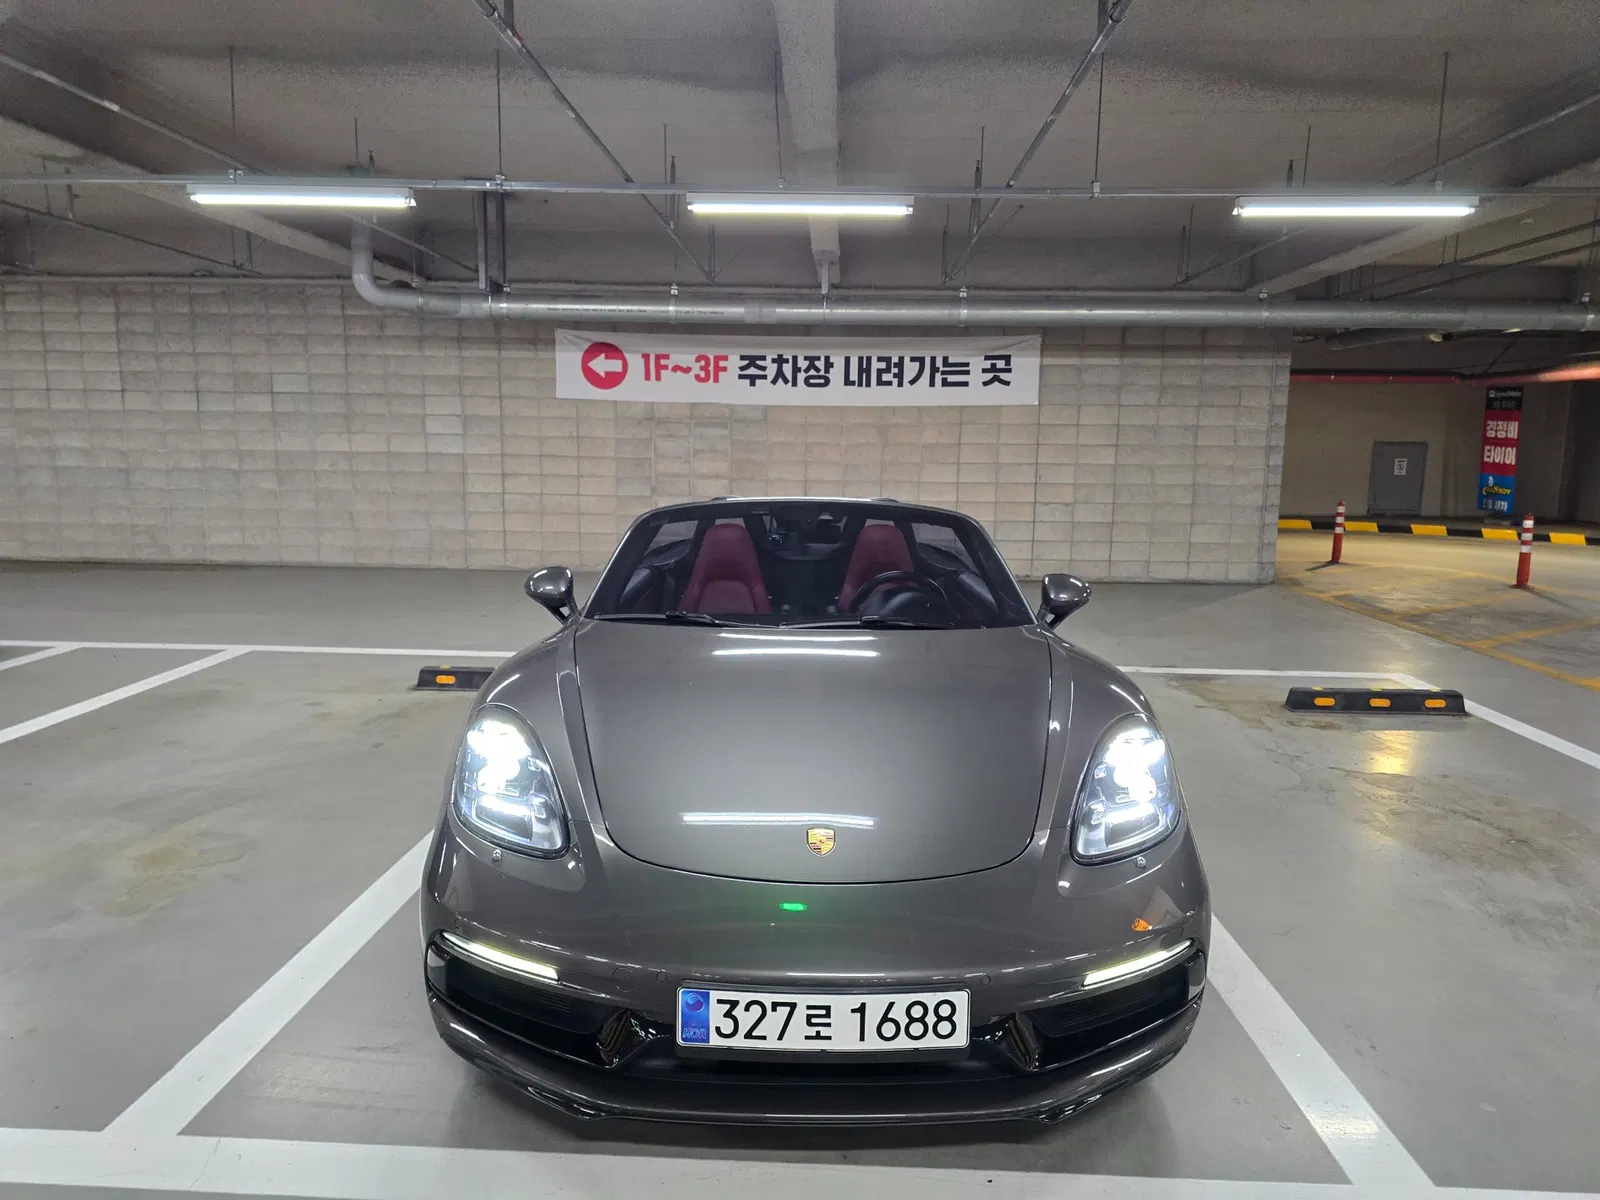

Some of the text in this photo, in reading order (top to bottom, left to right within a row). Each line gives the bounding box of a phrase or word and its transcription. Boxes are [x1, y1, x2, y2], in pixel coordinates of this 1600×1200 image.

[640, 352, 1014, 388] 1F~3F 주차장 내려가는 곳
[1486, 420, 1519, 439] 경정비
[1483, 445, 1517, 466] 타이어
[714, 998, 957, 1042] 327로 1688
